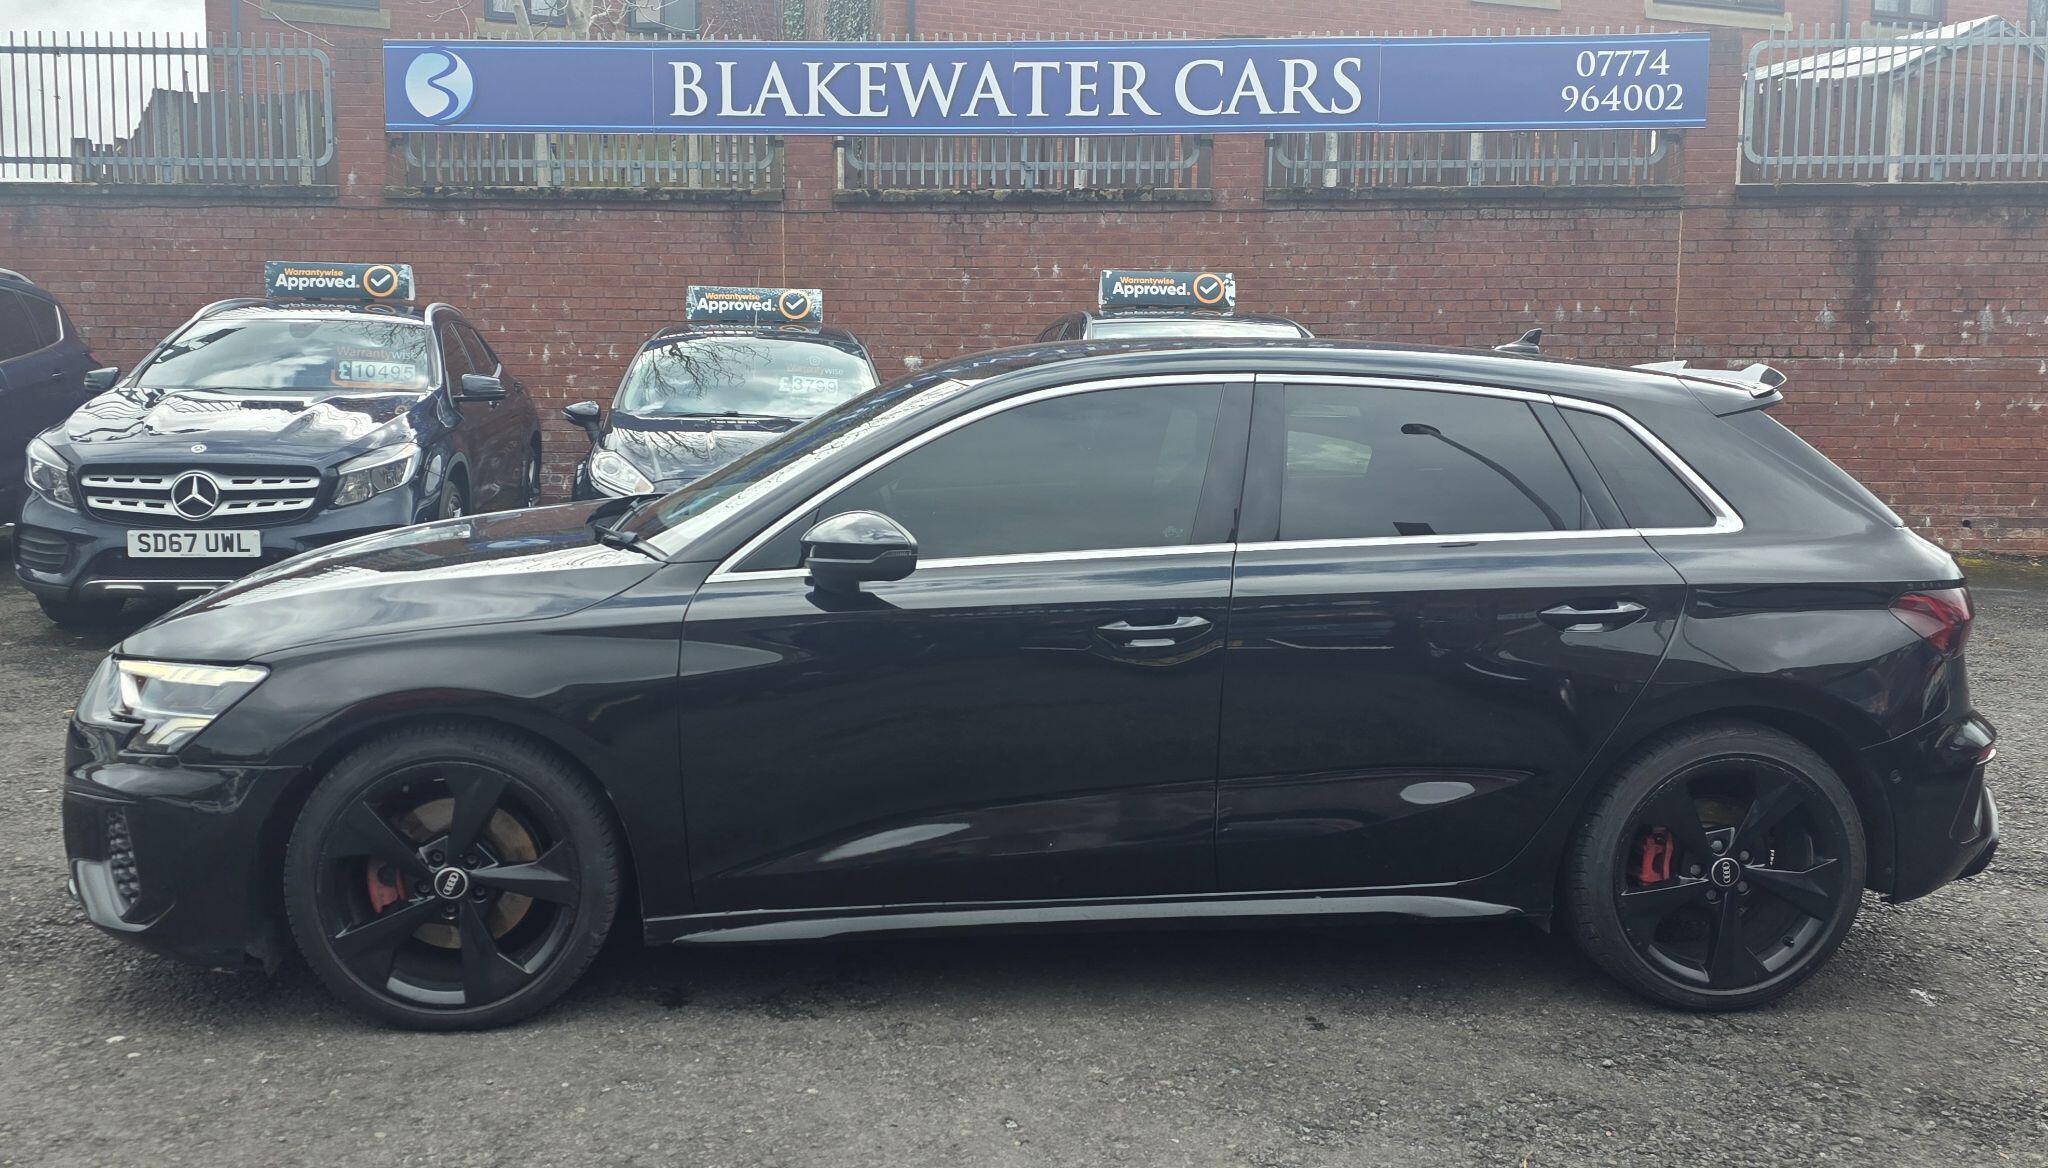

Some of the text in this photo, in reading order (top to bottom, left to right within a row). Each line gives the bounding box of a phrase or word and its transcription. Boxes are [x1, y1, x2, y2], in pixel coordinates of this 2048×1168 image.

[1576, 48, 1671, 78] 07774
[667, 57, 1362, 119] BLAKEWATER CARS
[1561, 83, 1684, 113] 964002
[284, 267, 344, 278] Warrantywise
[1119, 276, 1175, 285] Warrantywise
[275, 273, 361, 291] Approved.
[1112, 281, 1191, 298] Approved.
[705, 292, 760, 301] Warrantywise
[697, 297, 776, 314] Approved.
[337, 346, 417, 361] Warrantywise
[338, 361, 415, 380] £10495
[137, 533, 251, 553] SD67 UWL
